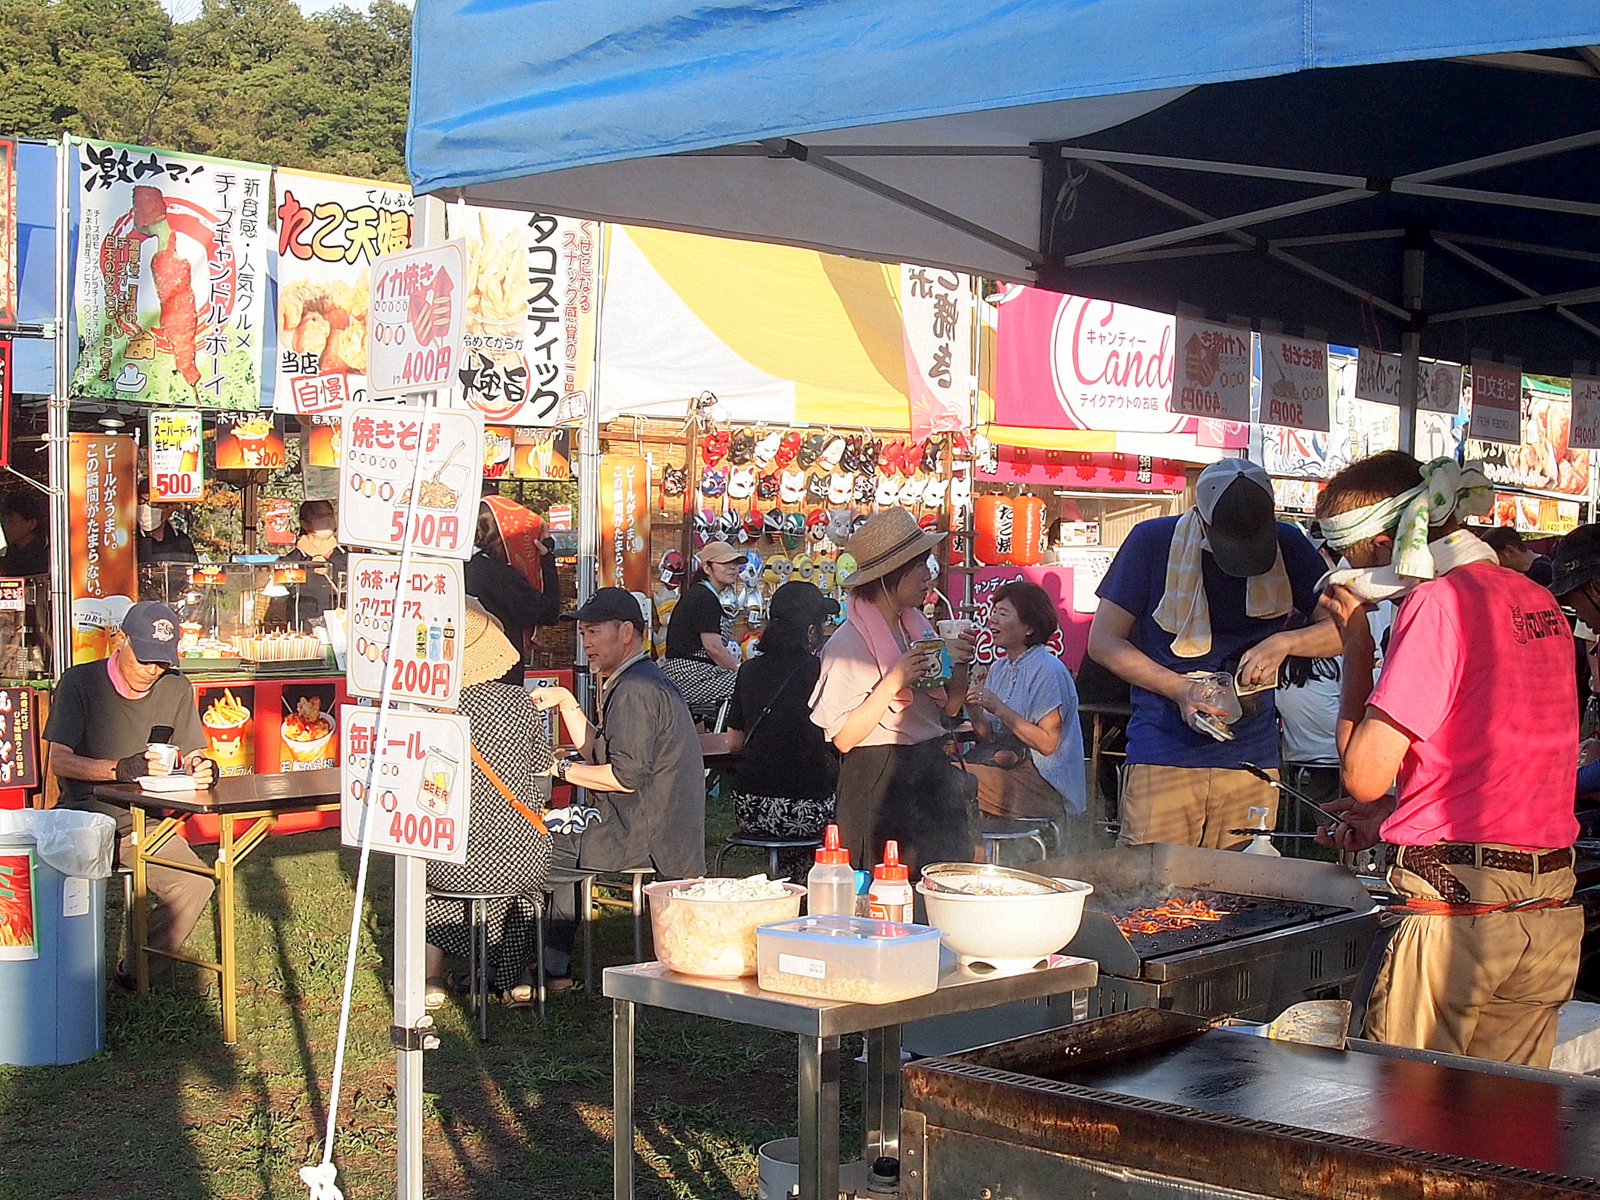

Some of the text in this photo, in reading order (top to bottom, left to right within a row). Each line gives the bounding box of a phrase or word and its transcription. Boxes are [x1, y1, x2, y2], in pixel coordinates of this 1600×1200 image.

[278, 190, 414, 265] たこ天婦
[236, 178, 261, 349] 新食感・人気グルメ
[376, 262, 435, 300] イカ焼き
[578, 219, 592, 313] くせになる
[203, 173, 237, 397] チーズキャンドル・ボーイ
[527, 213, 560, 419] タコスティック
[1072, 298, 1174, 389] Cand
[1087, 329, 1147, 348] キャンディー
[281, 351, 318, 375] 当店
[402, 346, 451, 385] 400円
[298, 378, 344, 408] 自慢
[1080, 393, 1158, 411] テイクアウトのお店
[154, 425, 198, 438] スーパードライ
[217, 412, 275, 426] ポテトフライ
[352, 416, 441, 452] 焼きそば
[155, 439, 182, 452] 生ビール
[103, 441, 118, 550] ビールがうまい。
[626, 465, 636, 555] ビールがうまい。
[86, 443, 101, 596] この瞬間がたまらない。
[390, 511, 459, 549] 50円
[613, 465, 626, 589] この瞬間がたまらない
[0, 588, 23, 600] そば
[391, 659, 450, 698] 200円
[350, 723, 427, 760] 缶ビール
[423, 780, 448, 802] BEER
[389, 811, 455, 851] 400円
